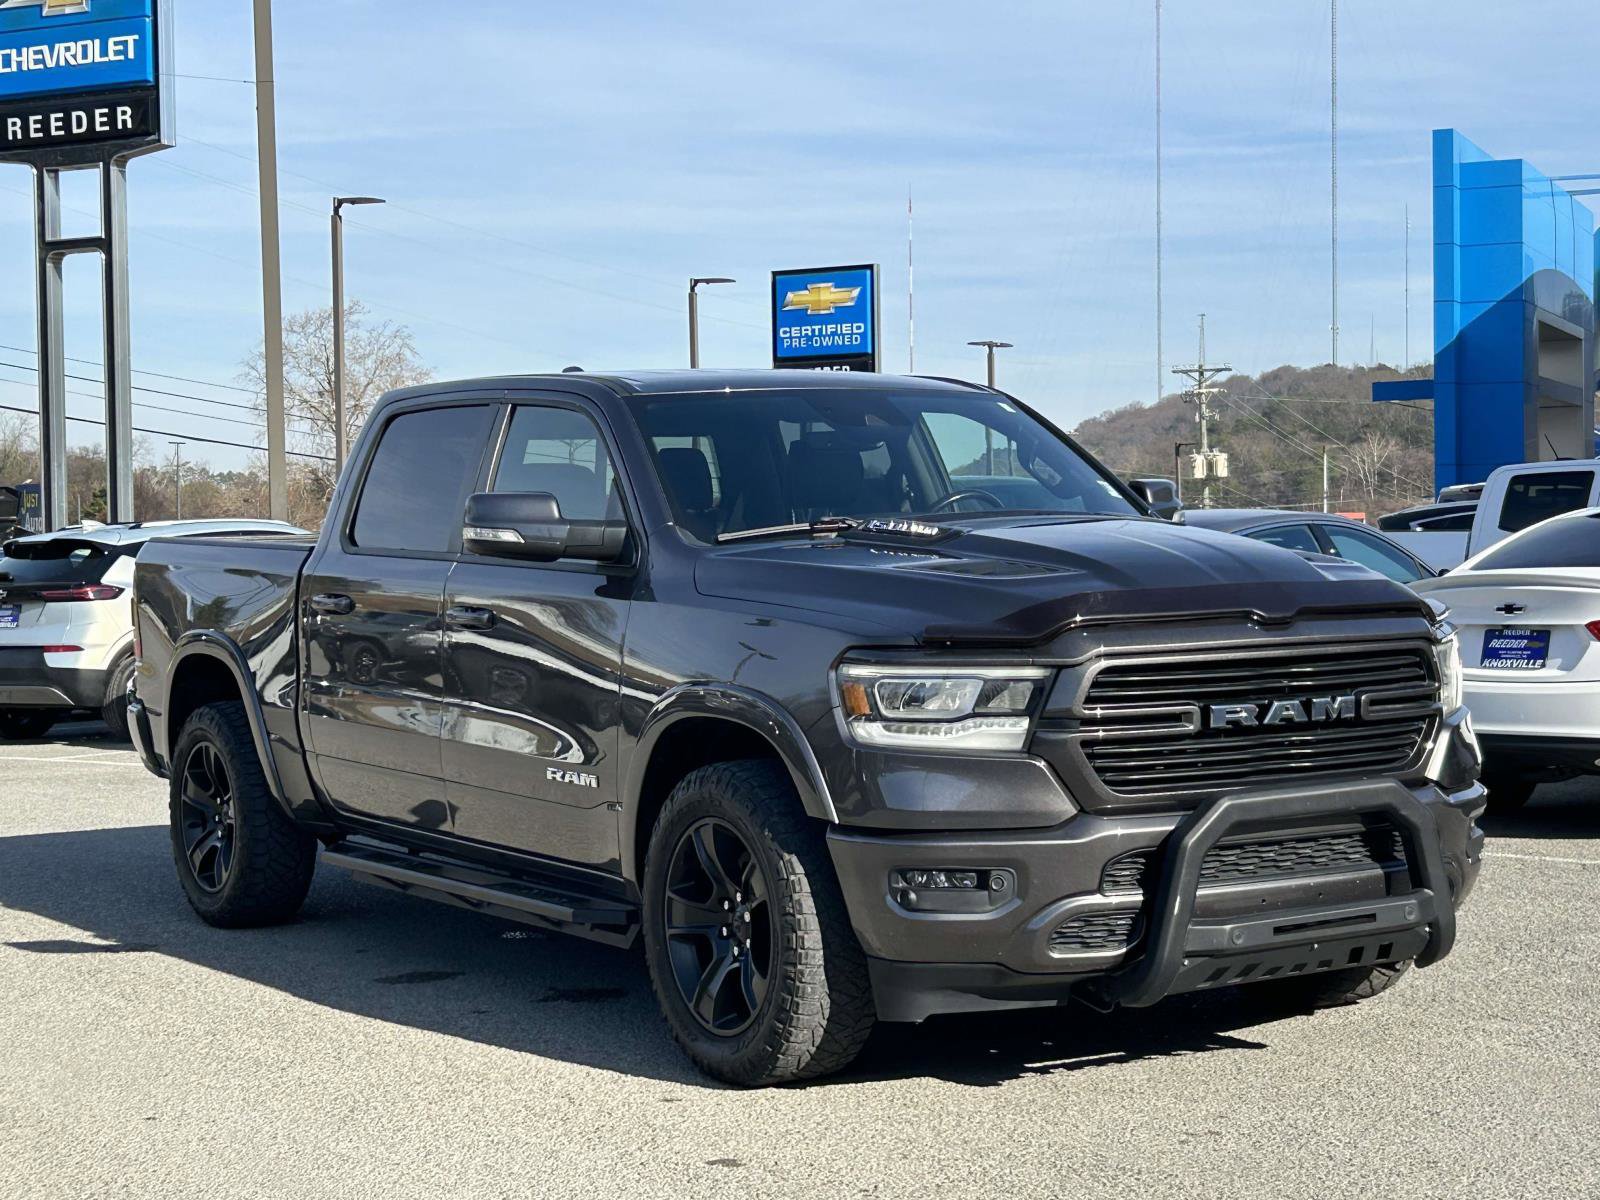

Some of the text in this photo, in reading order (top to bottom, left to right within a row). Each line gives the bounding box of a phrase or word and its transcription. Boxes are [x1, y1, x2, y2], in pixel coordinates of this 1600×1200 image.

[0, 35, 139, 73] CHEVROLET
[7, 106, 133, 140] REEDER
[779, 323, 865, 338] CERTIFIED
[783, 334, 861, 348] PRE-OWNED
[1488, 638, 1528, 648] REEDER
[1481, 658, 1544, 668] KNOXVILLE
[1209, 695, 1356, 728] RAM
[546, 766, 600, 788] RAM
